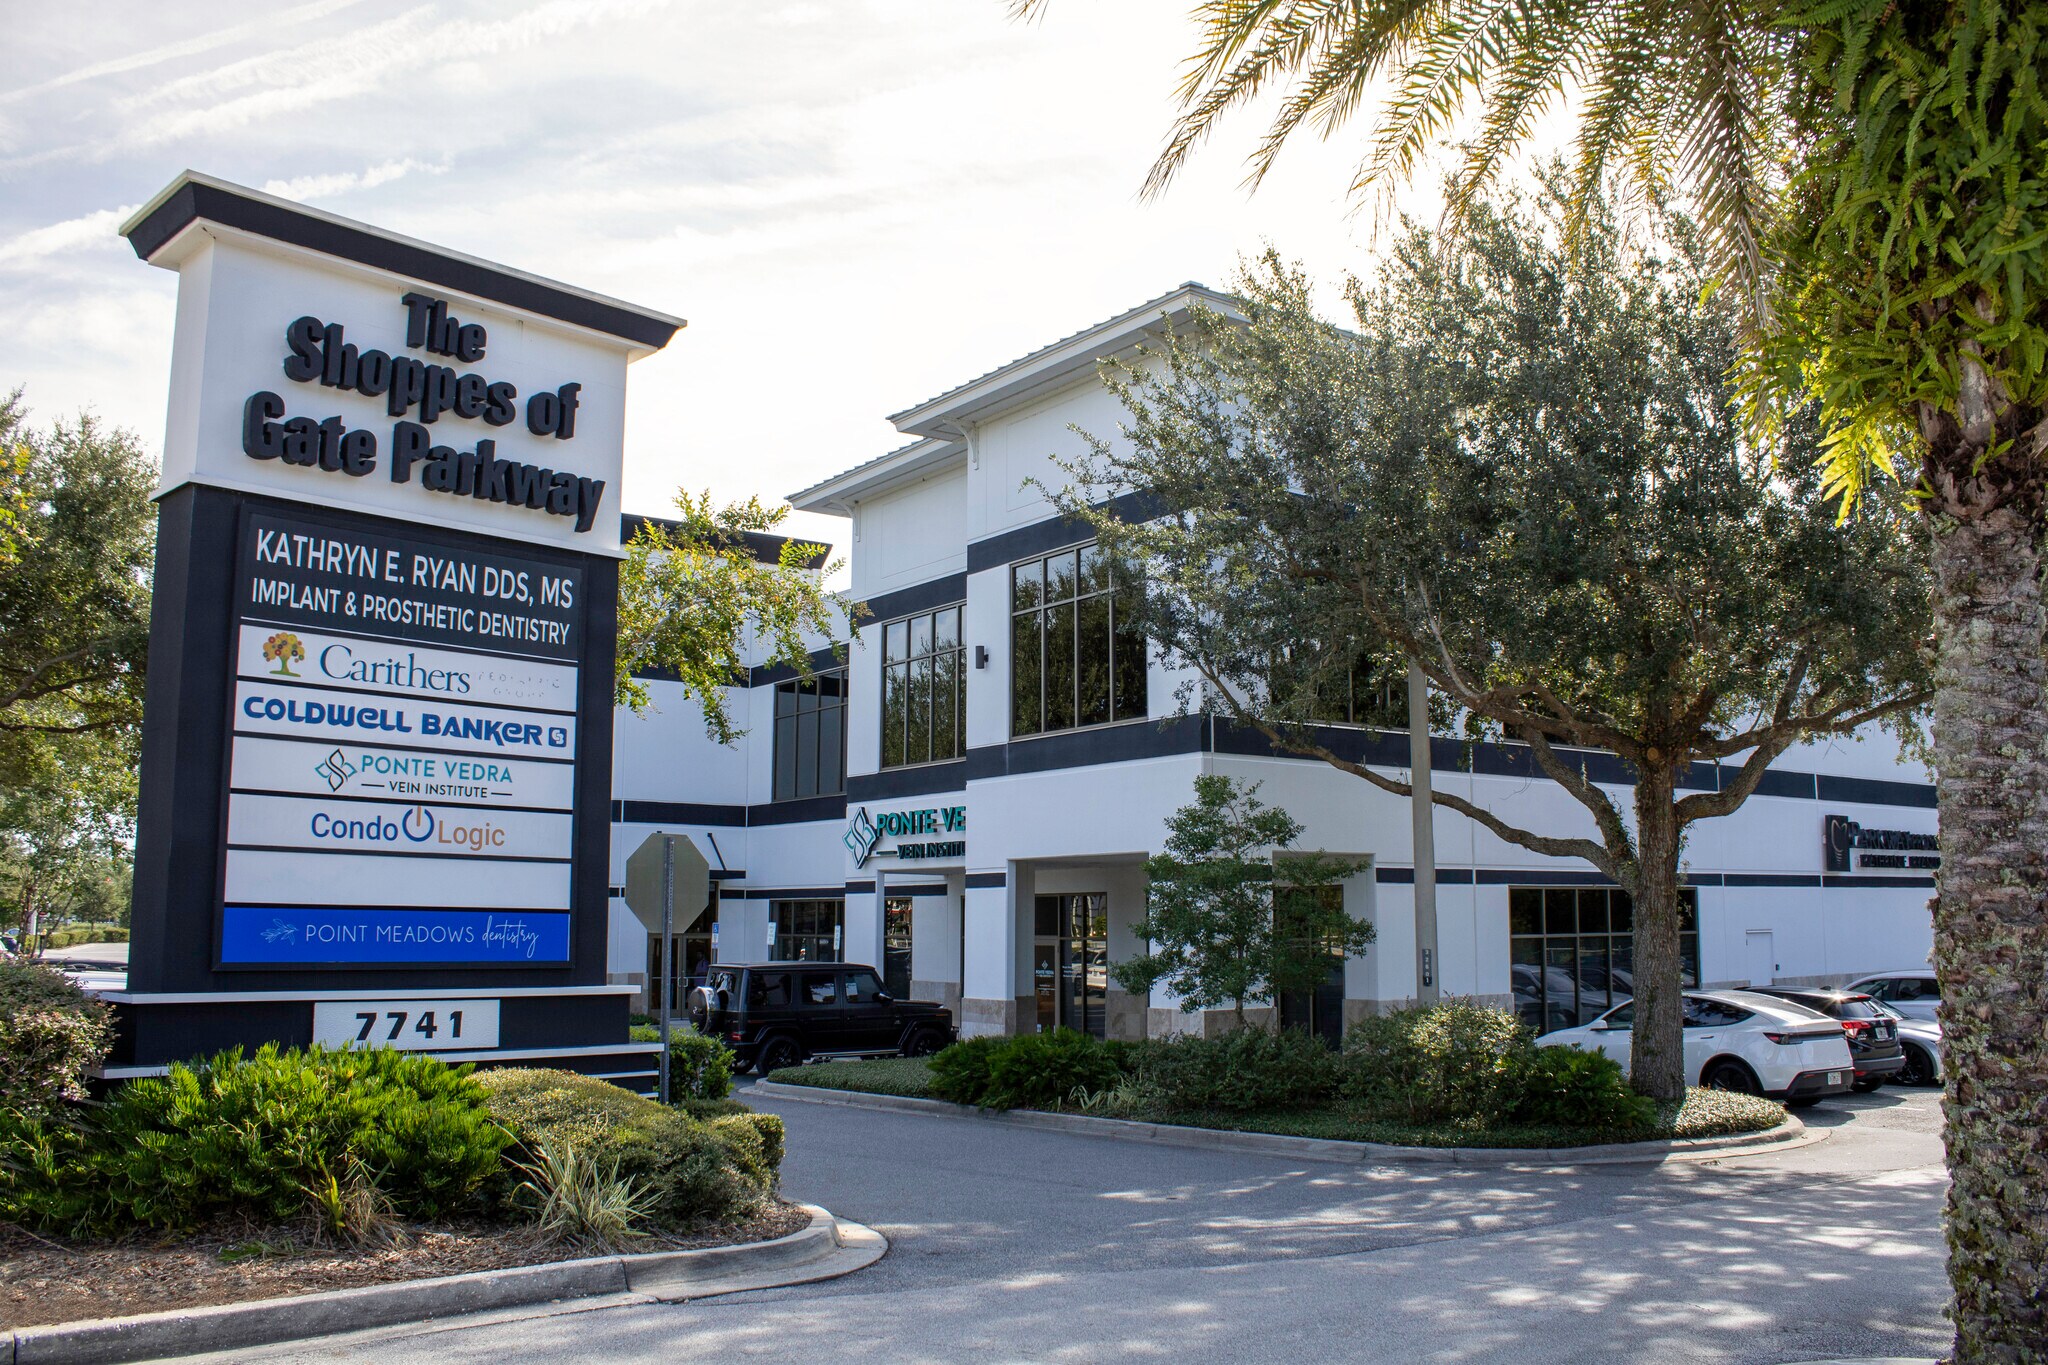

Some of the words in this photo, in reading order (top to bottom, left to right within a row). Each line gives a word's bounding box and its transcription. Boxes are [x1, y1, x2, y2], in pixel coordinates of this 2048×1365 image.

[402, 292, 487, 363] The
[284, 315, 517, 427] Shoppes
[527, 382, 582, 440] of
[243, 391, 377, 477] Gate
[391, 421, 606, 533] Parkway
[256, 529, 378, 579] KATHRYN
[385, 551, 404, 583] E.
[412, 555, 476, 594] RYAN
[483, 565, 533, 607] DDS,
[541, 576, 573, 609] MS
[252, 578, 341, 613] IMPLANT
[345, 592, 357, 616] &
[363, 594, 473, 633] PROSTHETIC
[479, 612, 570, 645] DENTISTRY
[319, 644, 471, 694] Carithers
[362, 754, 435, 778] PONTE
[444, 762, 513, 784] VEDRA
[389, 781, 420, 794] VEIN
[425, 782, 488, 799] INSTITUTE
[311, 812, 398, 841] Condo
[438, 820, 505, 851] Logic
[876, 809, 937, 838] PONTE
[897, 843, 925, 859] VEIN
[305, 924, 368, 943] POINT
[377, 925, 475, 943] MEADOWS
[482, 915, 539, 958] dentistry
[355, 1010, 463, 1041] 7741
